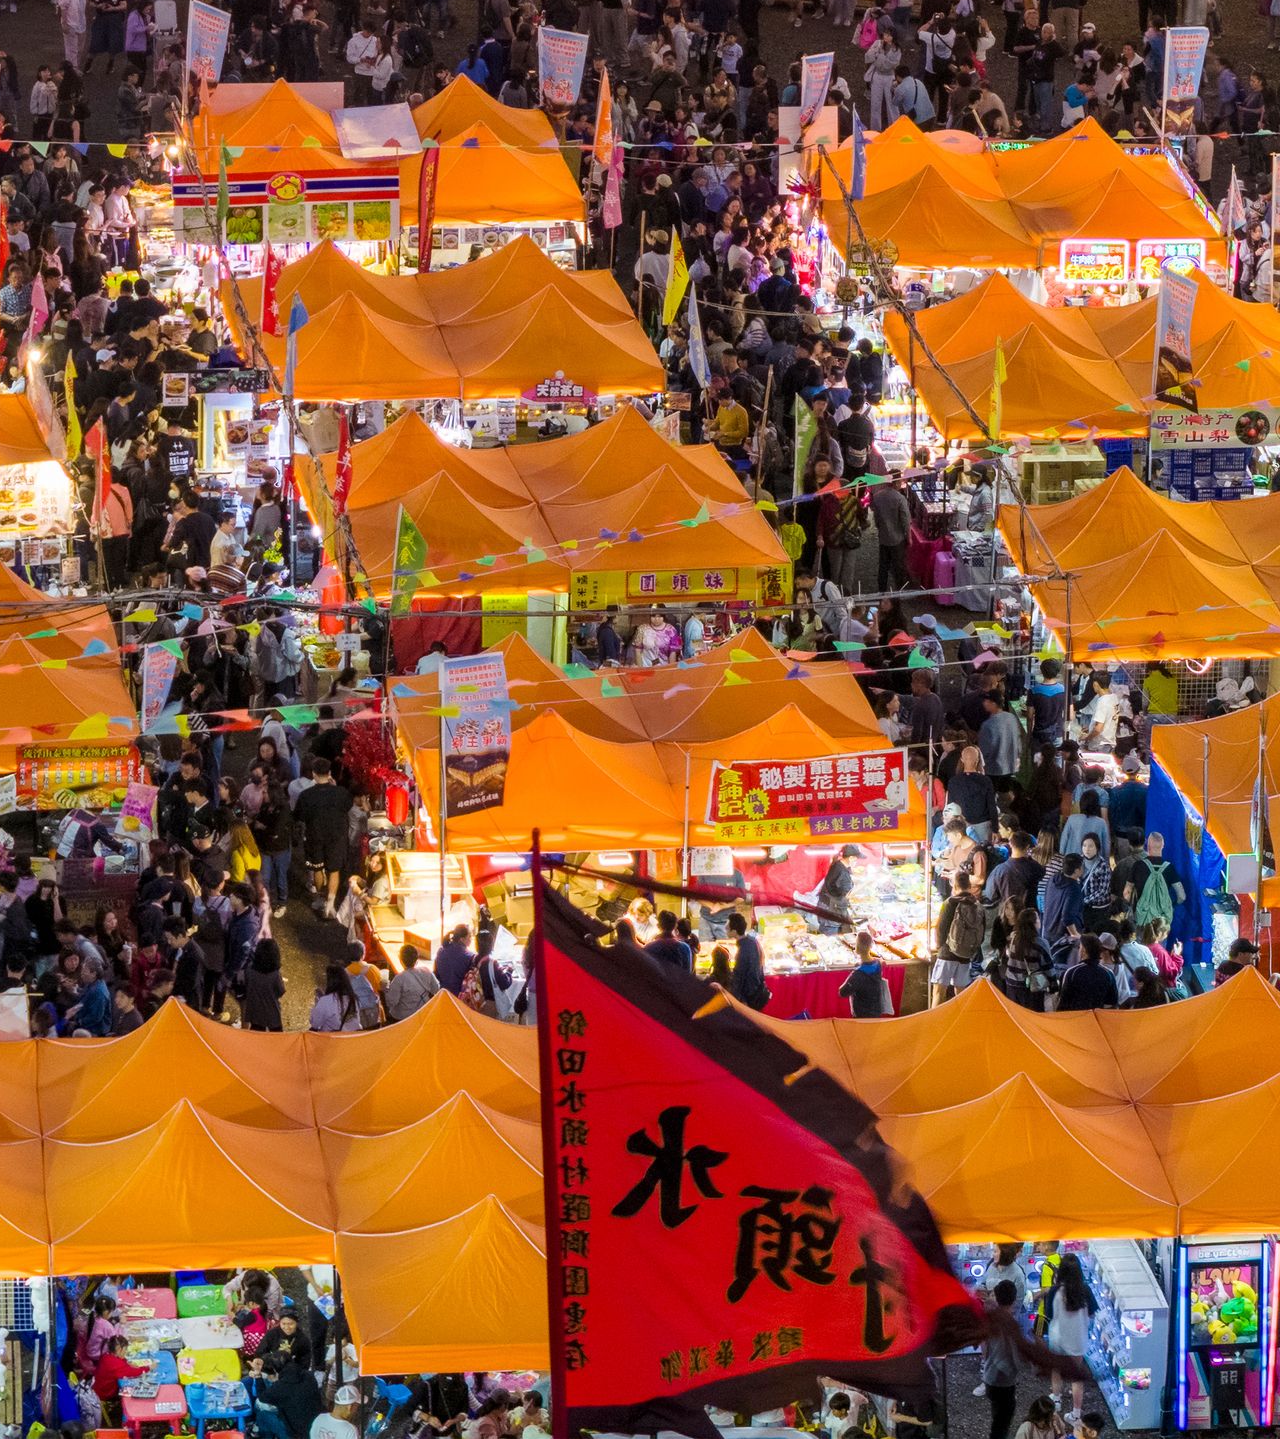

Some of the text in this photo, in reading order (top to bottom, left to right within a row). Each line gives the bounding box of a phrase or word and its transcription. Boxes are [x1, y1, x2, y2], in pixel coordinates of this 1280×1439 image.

[1160, 429, 1230, 445] 雪山梨
[759, 764, 807, 790] 秘製
[810, 771, 888, 790] 花生糖
[718, 768, 744, 818] 食神記
[721, 821, 799, 839] 彈牙香蕉糕
[814, 814, 892, 833] 秘製老陳皮
